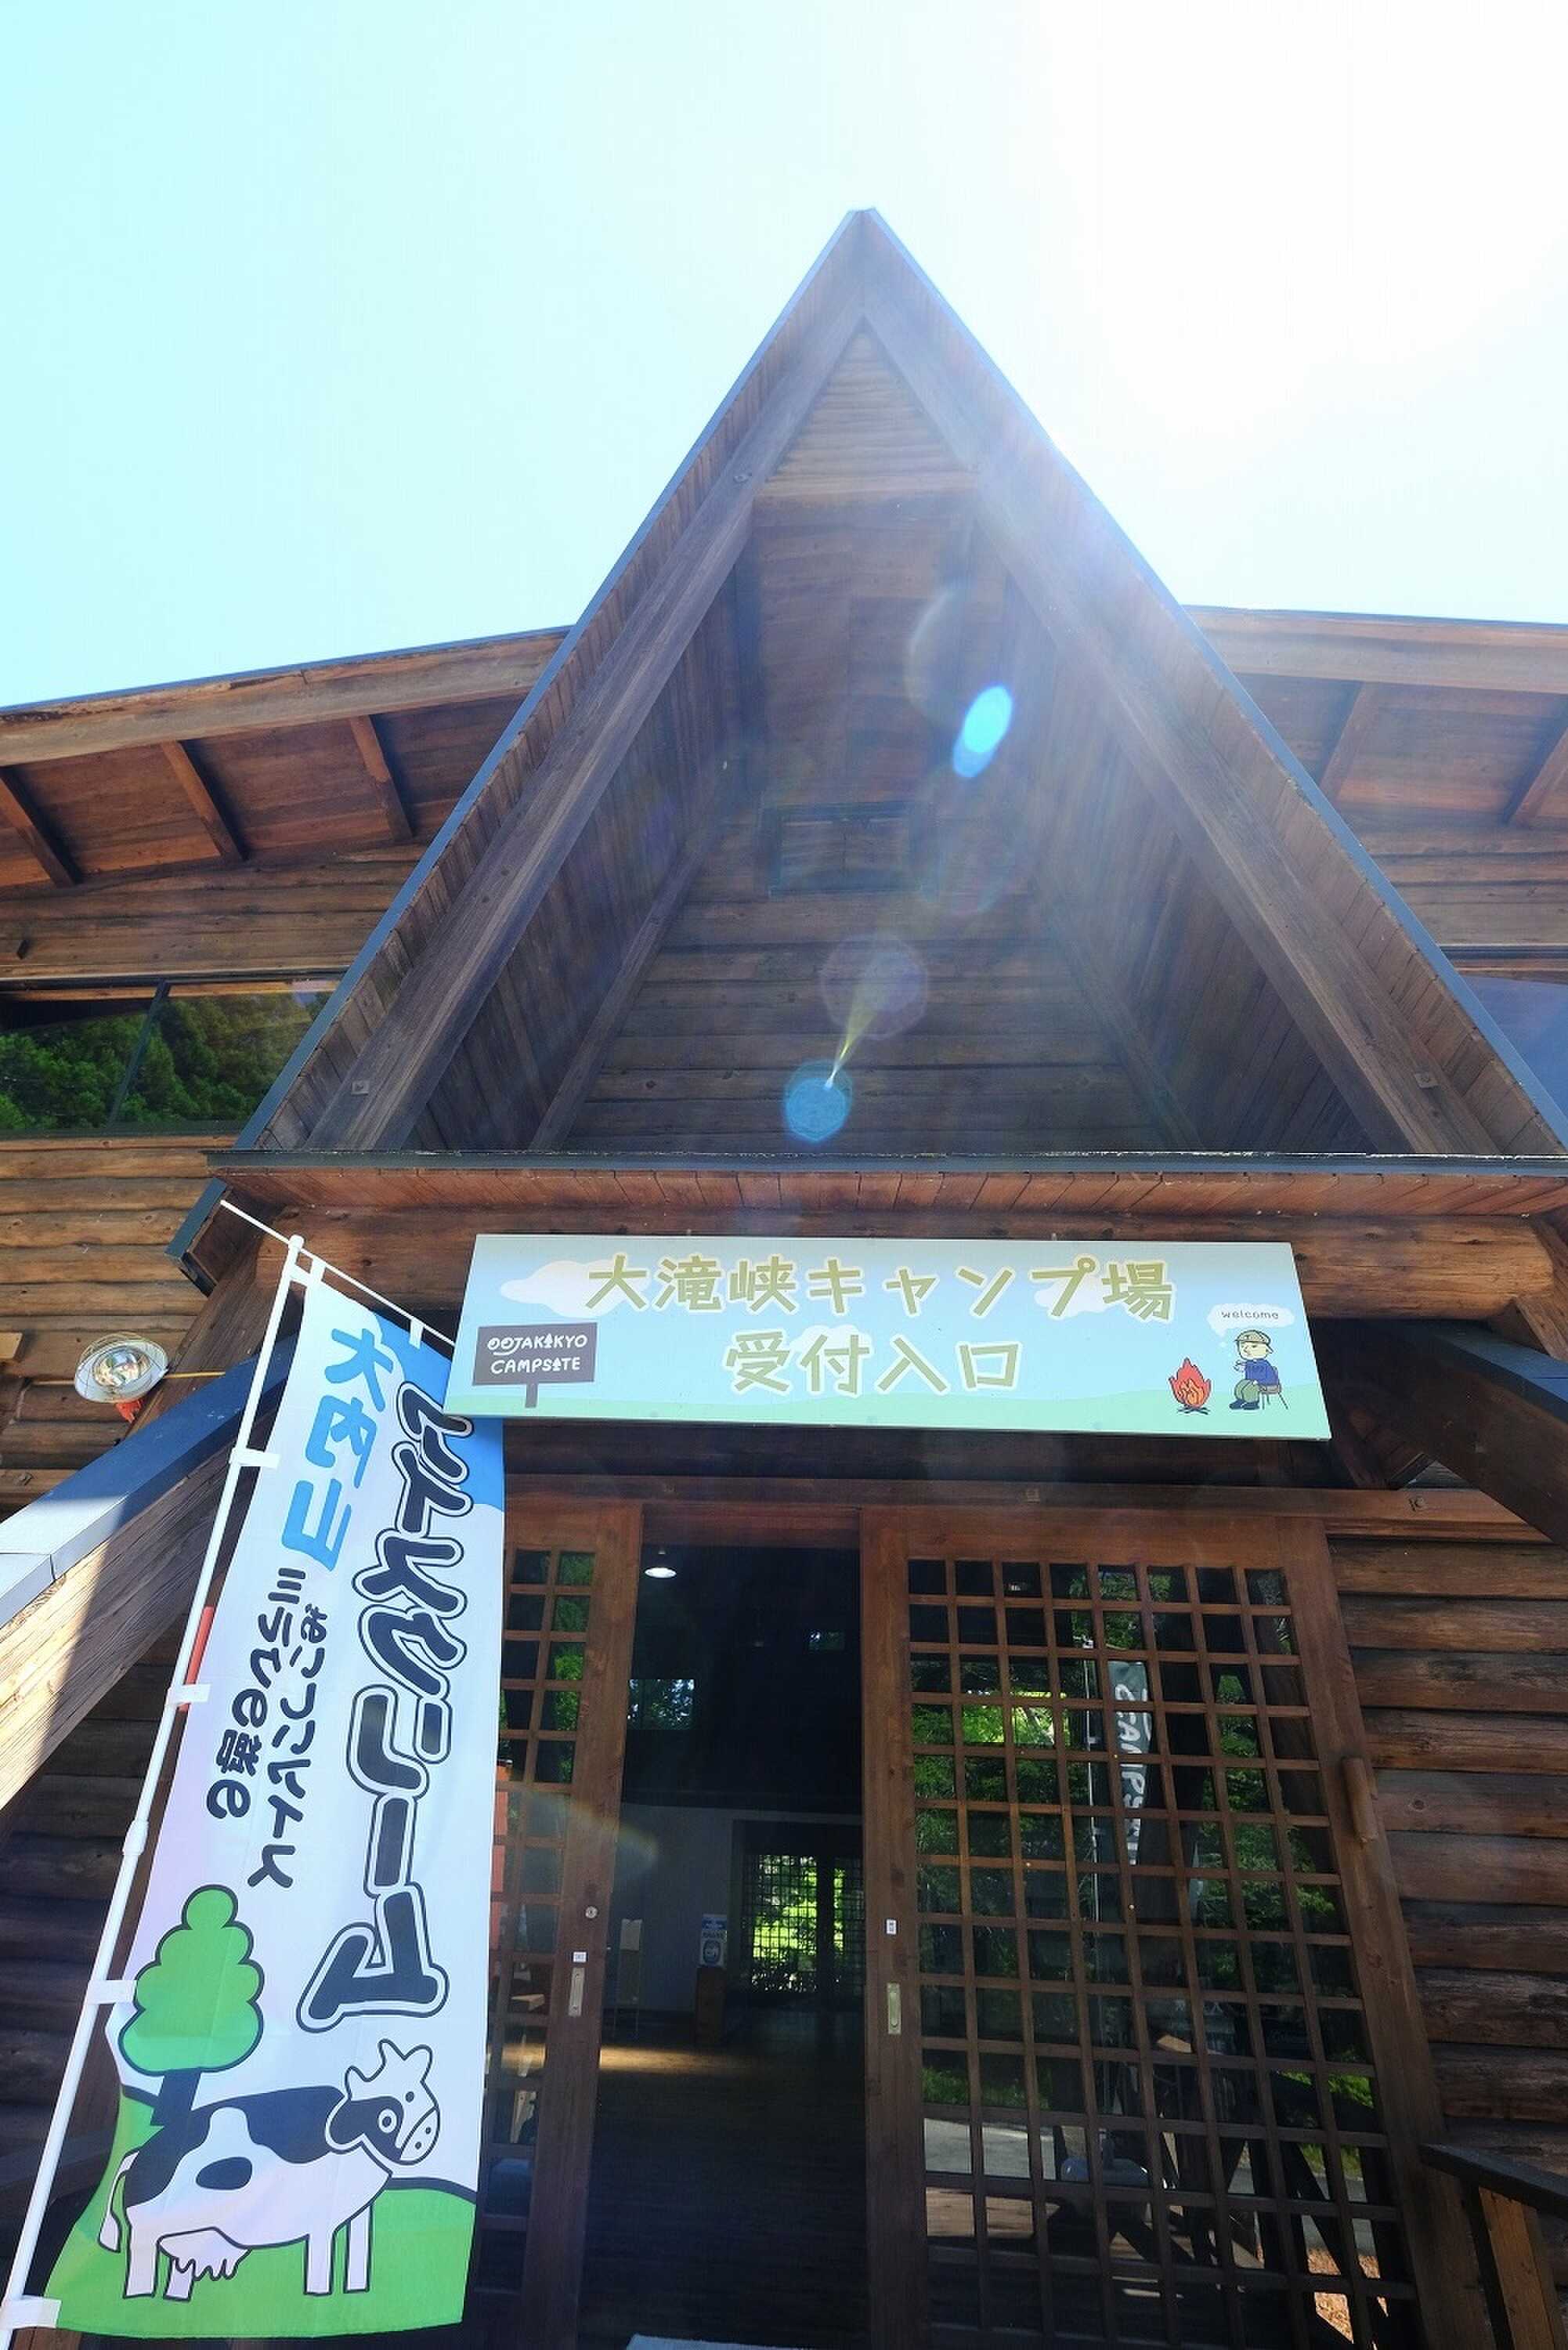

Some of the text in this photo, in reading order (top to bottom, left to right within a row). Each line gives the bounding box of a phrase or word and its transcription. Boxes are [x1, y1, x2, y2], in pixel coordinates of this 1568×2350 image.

[584, 1253, 1173, 1321] 大滝峡キャンプ場
[1221, 1310, 1279, 1319] welcome
[490, 1357, 581, 1375] CAMPSITE
[724, 1331, 1020, 1394] 受付入口
